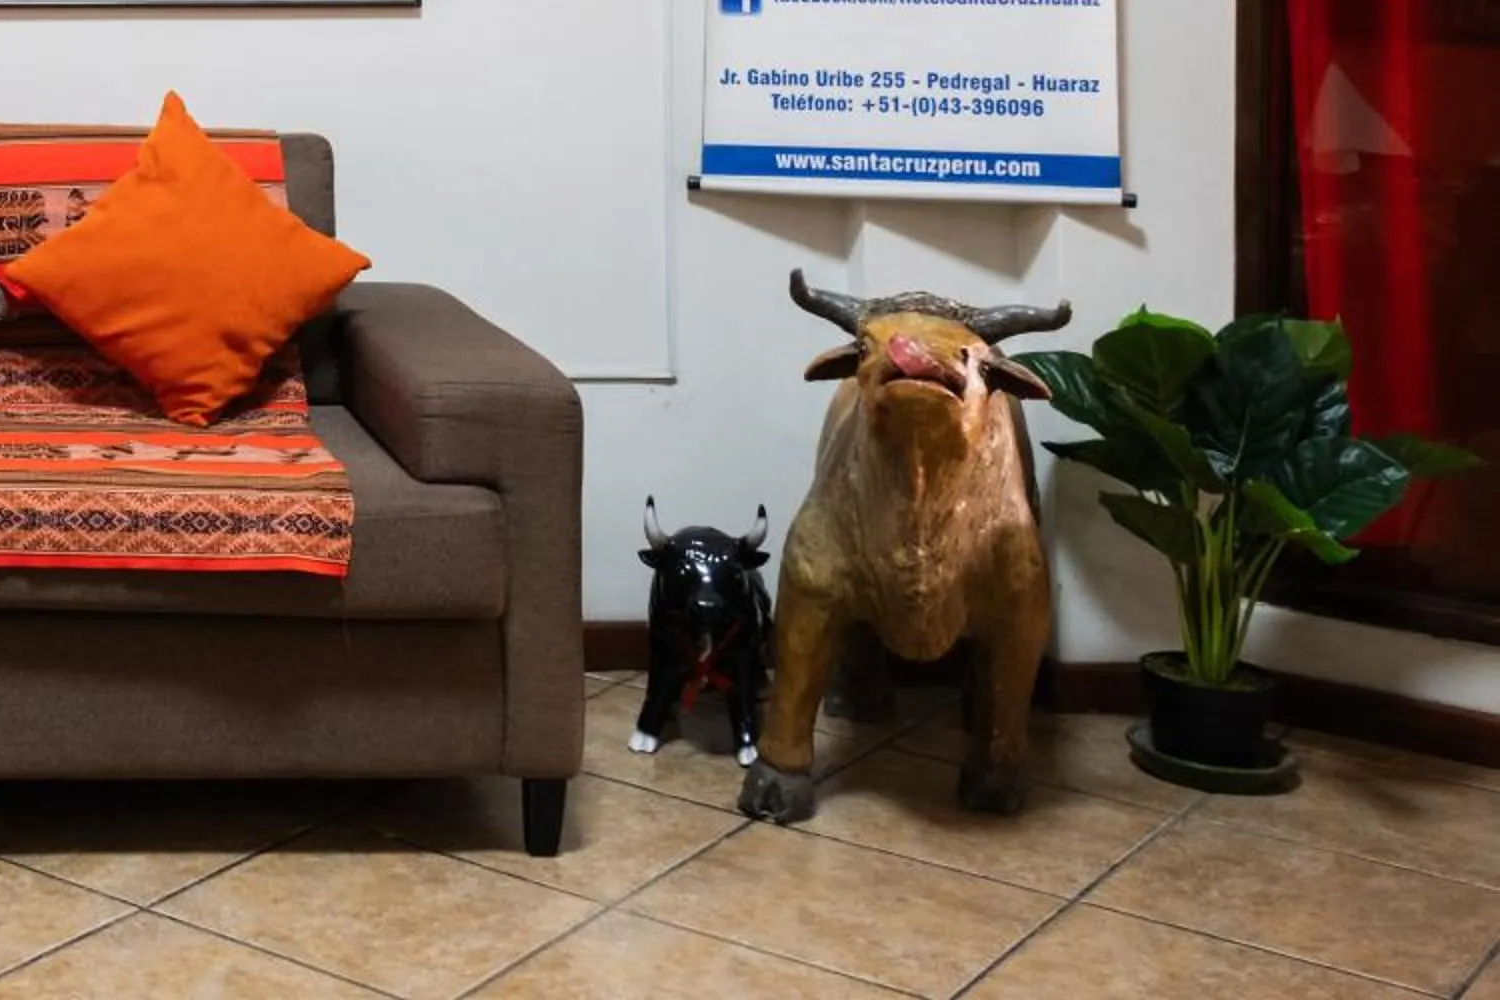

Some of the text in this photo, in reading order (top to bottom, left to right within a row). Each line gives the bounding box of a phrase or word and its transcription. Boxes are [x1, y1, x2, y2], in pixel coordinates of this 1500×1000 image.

[719, 69, 741, 86] Jr.
[747, 70, 809, 87] Gabino
[816, 70, 864, 88] Uribe
[871, 72, 905, 89] 255
[927, 73, 1010, 93] Pedregal
[1033, 75, 1100, 92] Huaraz
[772, 93, 1045, 117] Teléfono: +51-(0)43-396096
[776, 152, 1041, 178] www.santacruzperu.com
